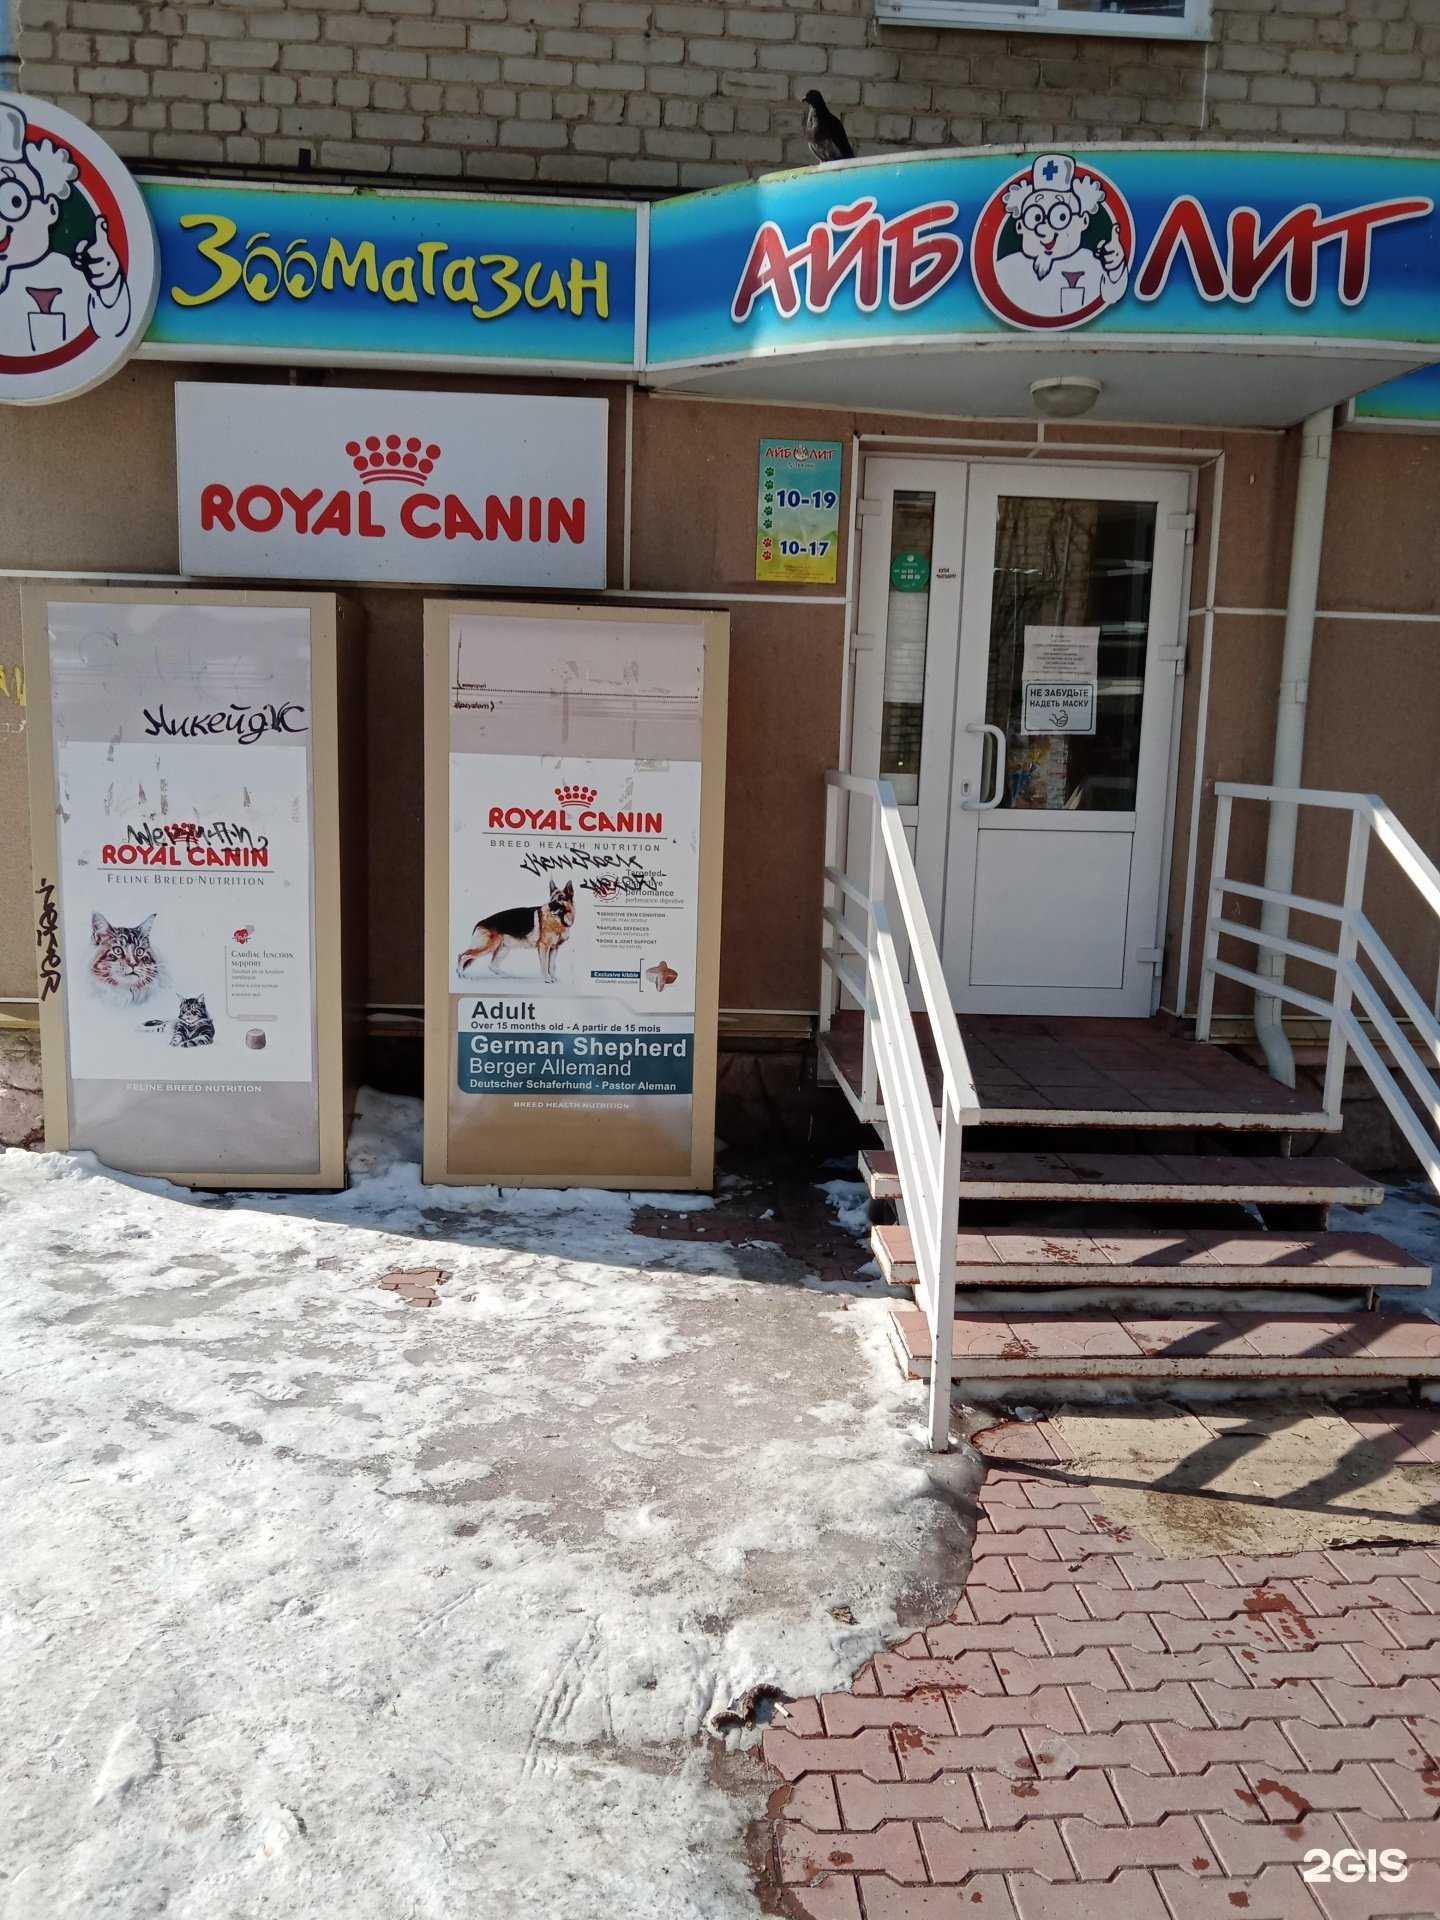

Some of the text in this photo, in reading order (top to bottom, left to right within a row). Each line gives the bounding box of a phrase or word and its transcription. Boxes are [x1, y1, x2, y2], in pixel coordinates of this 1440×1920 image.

[777, 490, 837, 509] 10-19
[199, 483, 586, 544] ROYAL CANIN
[780, 540, 829, 556] 10-17
[1030, 688, 1089, 697] НЕ ЗАБУДЬТЕ
[1029, 700, 1089, 708] НАДЕТЬ МАСКУ
[488, 807, 662, 833] ROYAL CANIN
[490, 839, 661, 852] BREED HEALTH NUTRITION
[102, 844, 269, 867] ROYAL CANIN
[107, 873, 265, 886] FELINE BREED NUTRITION
[471, 1001, 536, 1020] Adult
[470, 1021, 494, 1030] Over
[497, 1022, 508, 1030] 15
[510, 1022, 546, 1031] months
[549, 1023, 564, 1031] old
[572, 1023, 580, 1031] A
[582, 1023, 608, 1033] partir
[610, 1024, 622, 1032] de
[625, 1024, 636, 1032] 15
[638, 1024, 661, 1033] mois
[470, 1035, 687, 1060] German Shepherd
[470, 1058, 631, 1078] Berger Allemand
[126, 1082, 262, 1093] FELINE BREED NUTRITION
[470, 1079, 523, 1089] Deutscher
[526, 1080, 592, 1089] Schaferhund
[602, 1082, 635, 1090] Pastor
[637, 1082, 677, 1091] Aleman
